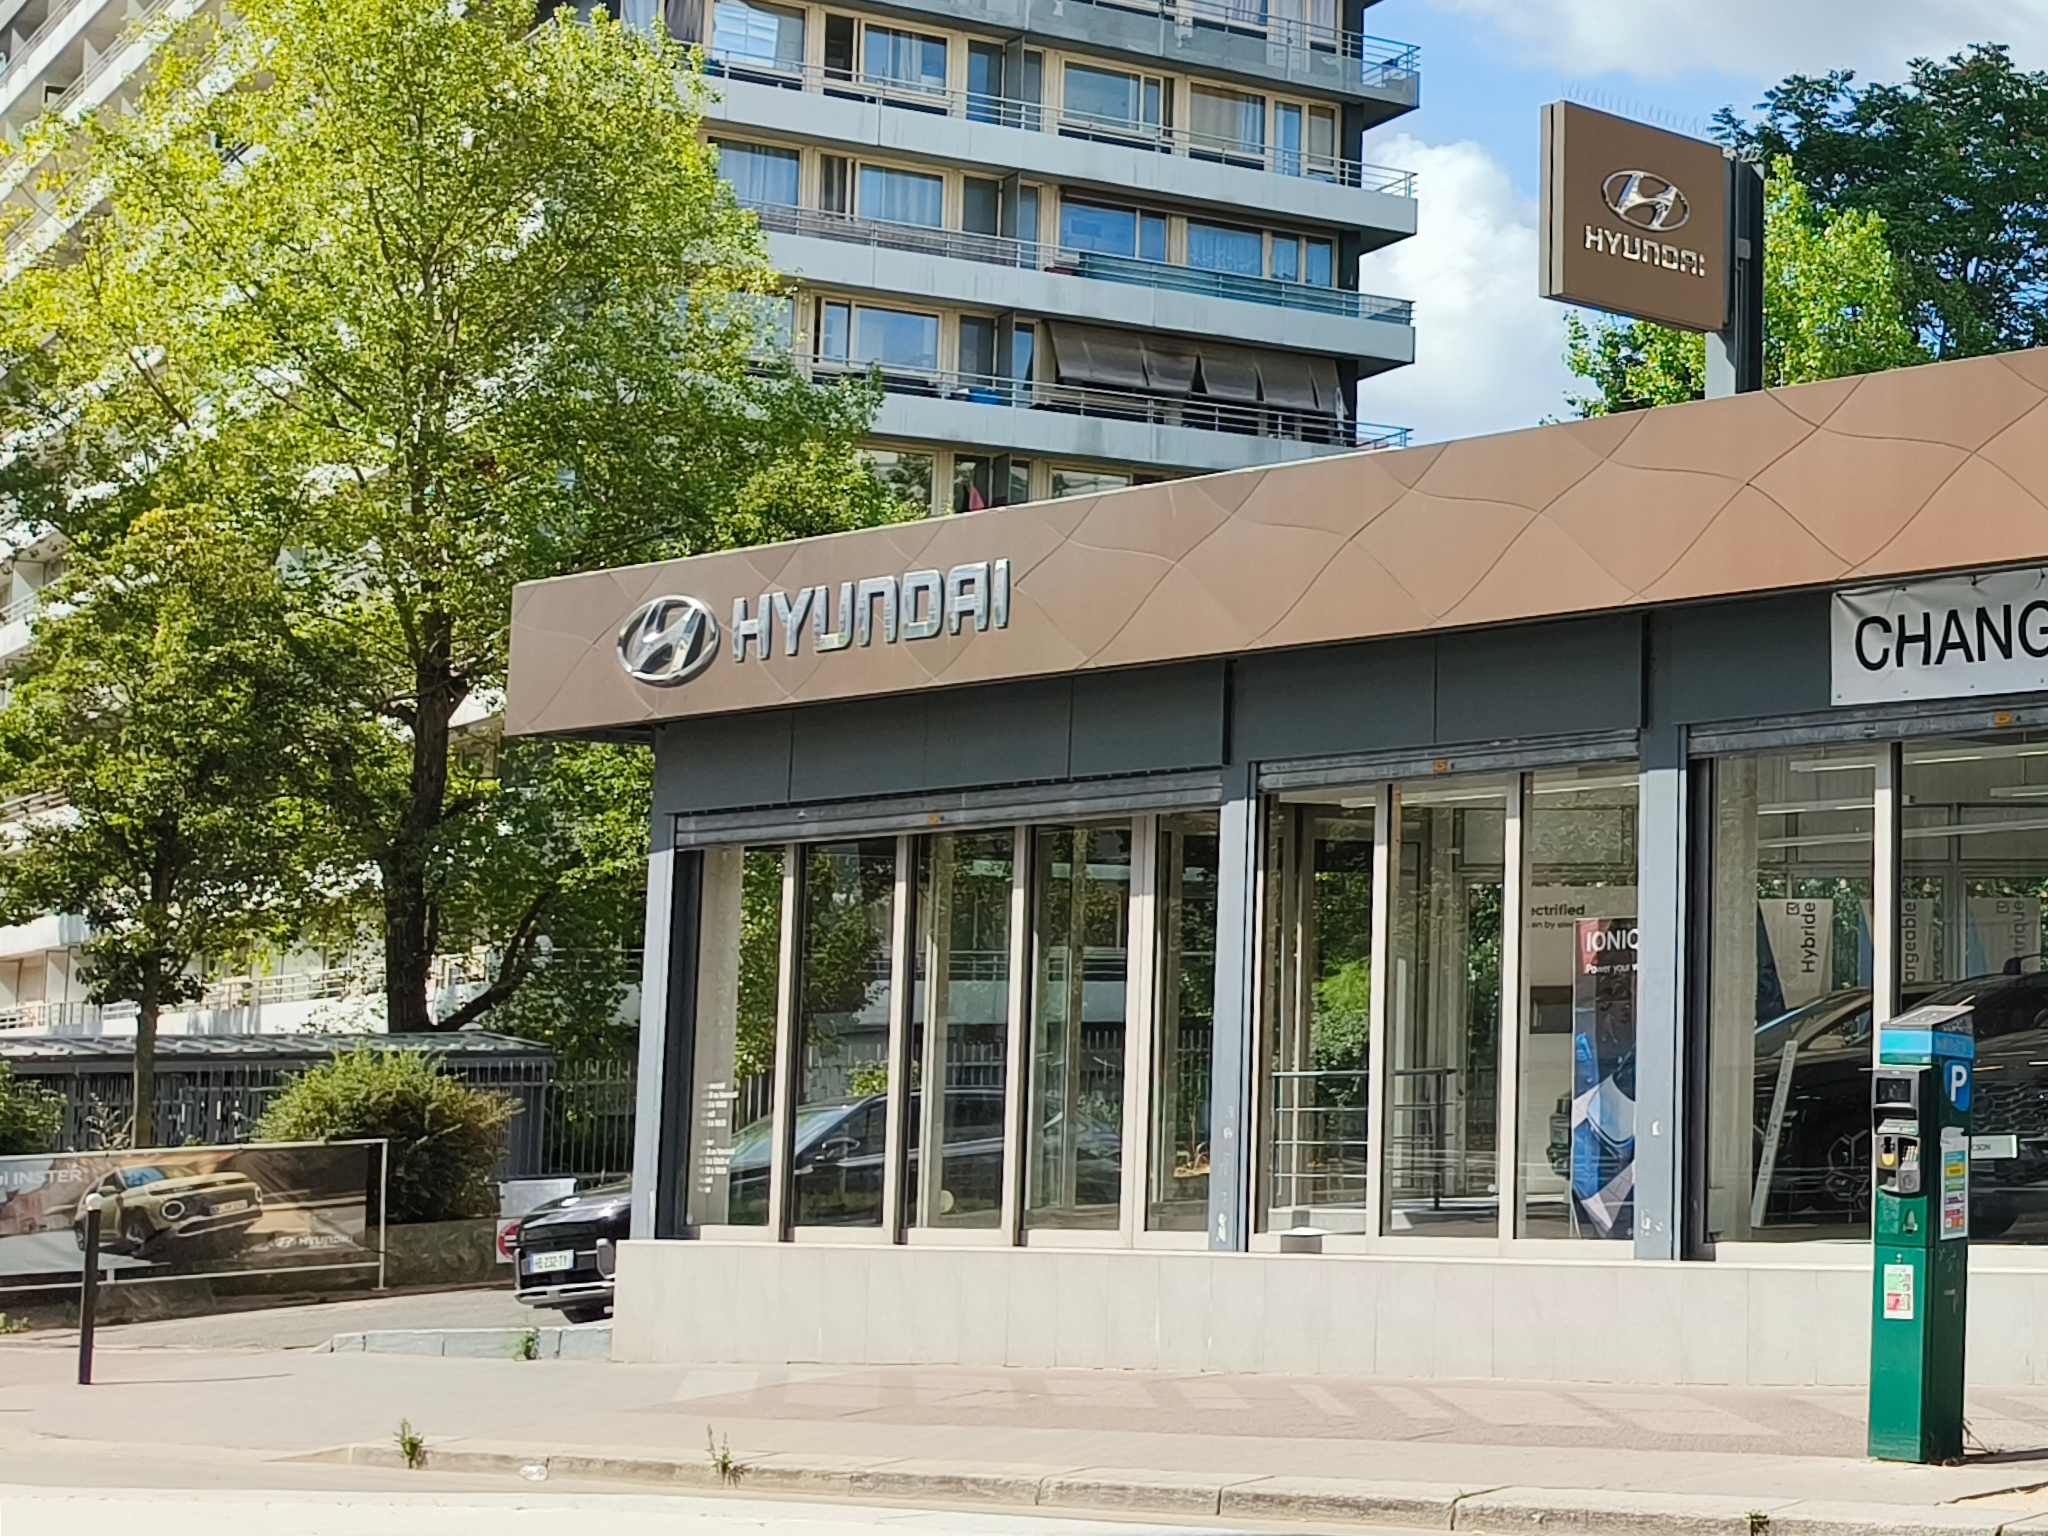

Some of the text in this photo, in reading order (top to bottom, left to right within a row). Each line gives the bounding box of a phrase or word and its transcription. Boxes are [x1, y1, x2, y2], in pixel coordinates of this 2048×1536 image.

[1584, 225, 1706, 277] HYUNDAI
[732, 557, 1010, 663] HYUNDAI
[1855, 600, 2048, 671] CHANG
[1801, 902, 1816, 973] Hybride
[1950, 1065, 1967, 1102] P
[13, 1169, 83, 1185] INSTER
